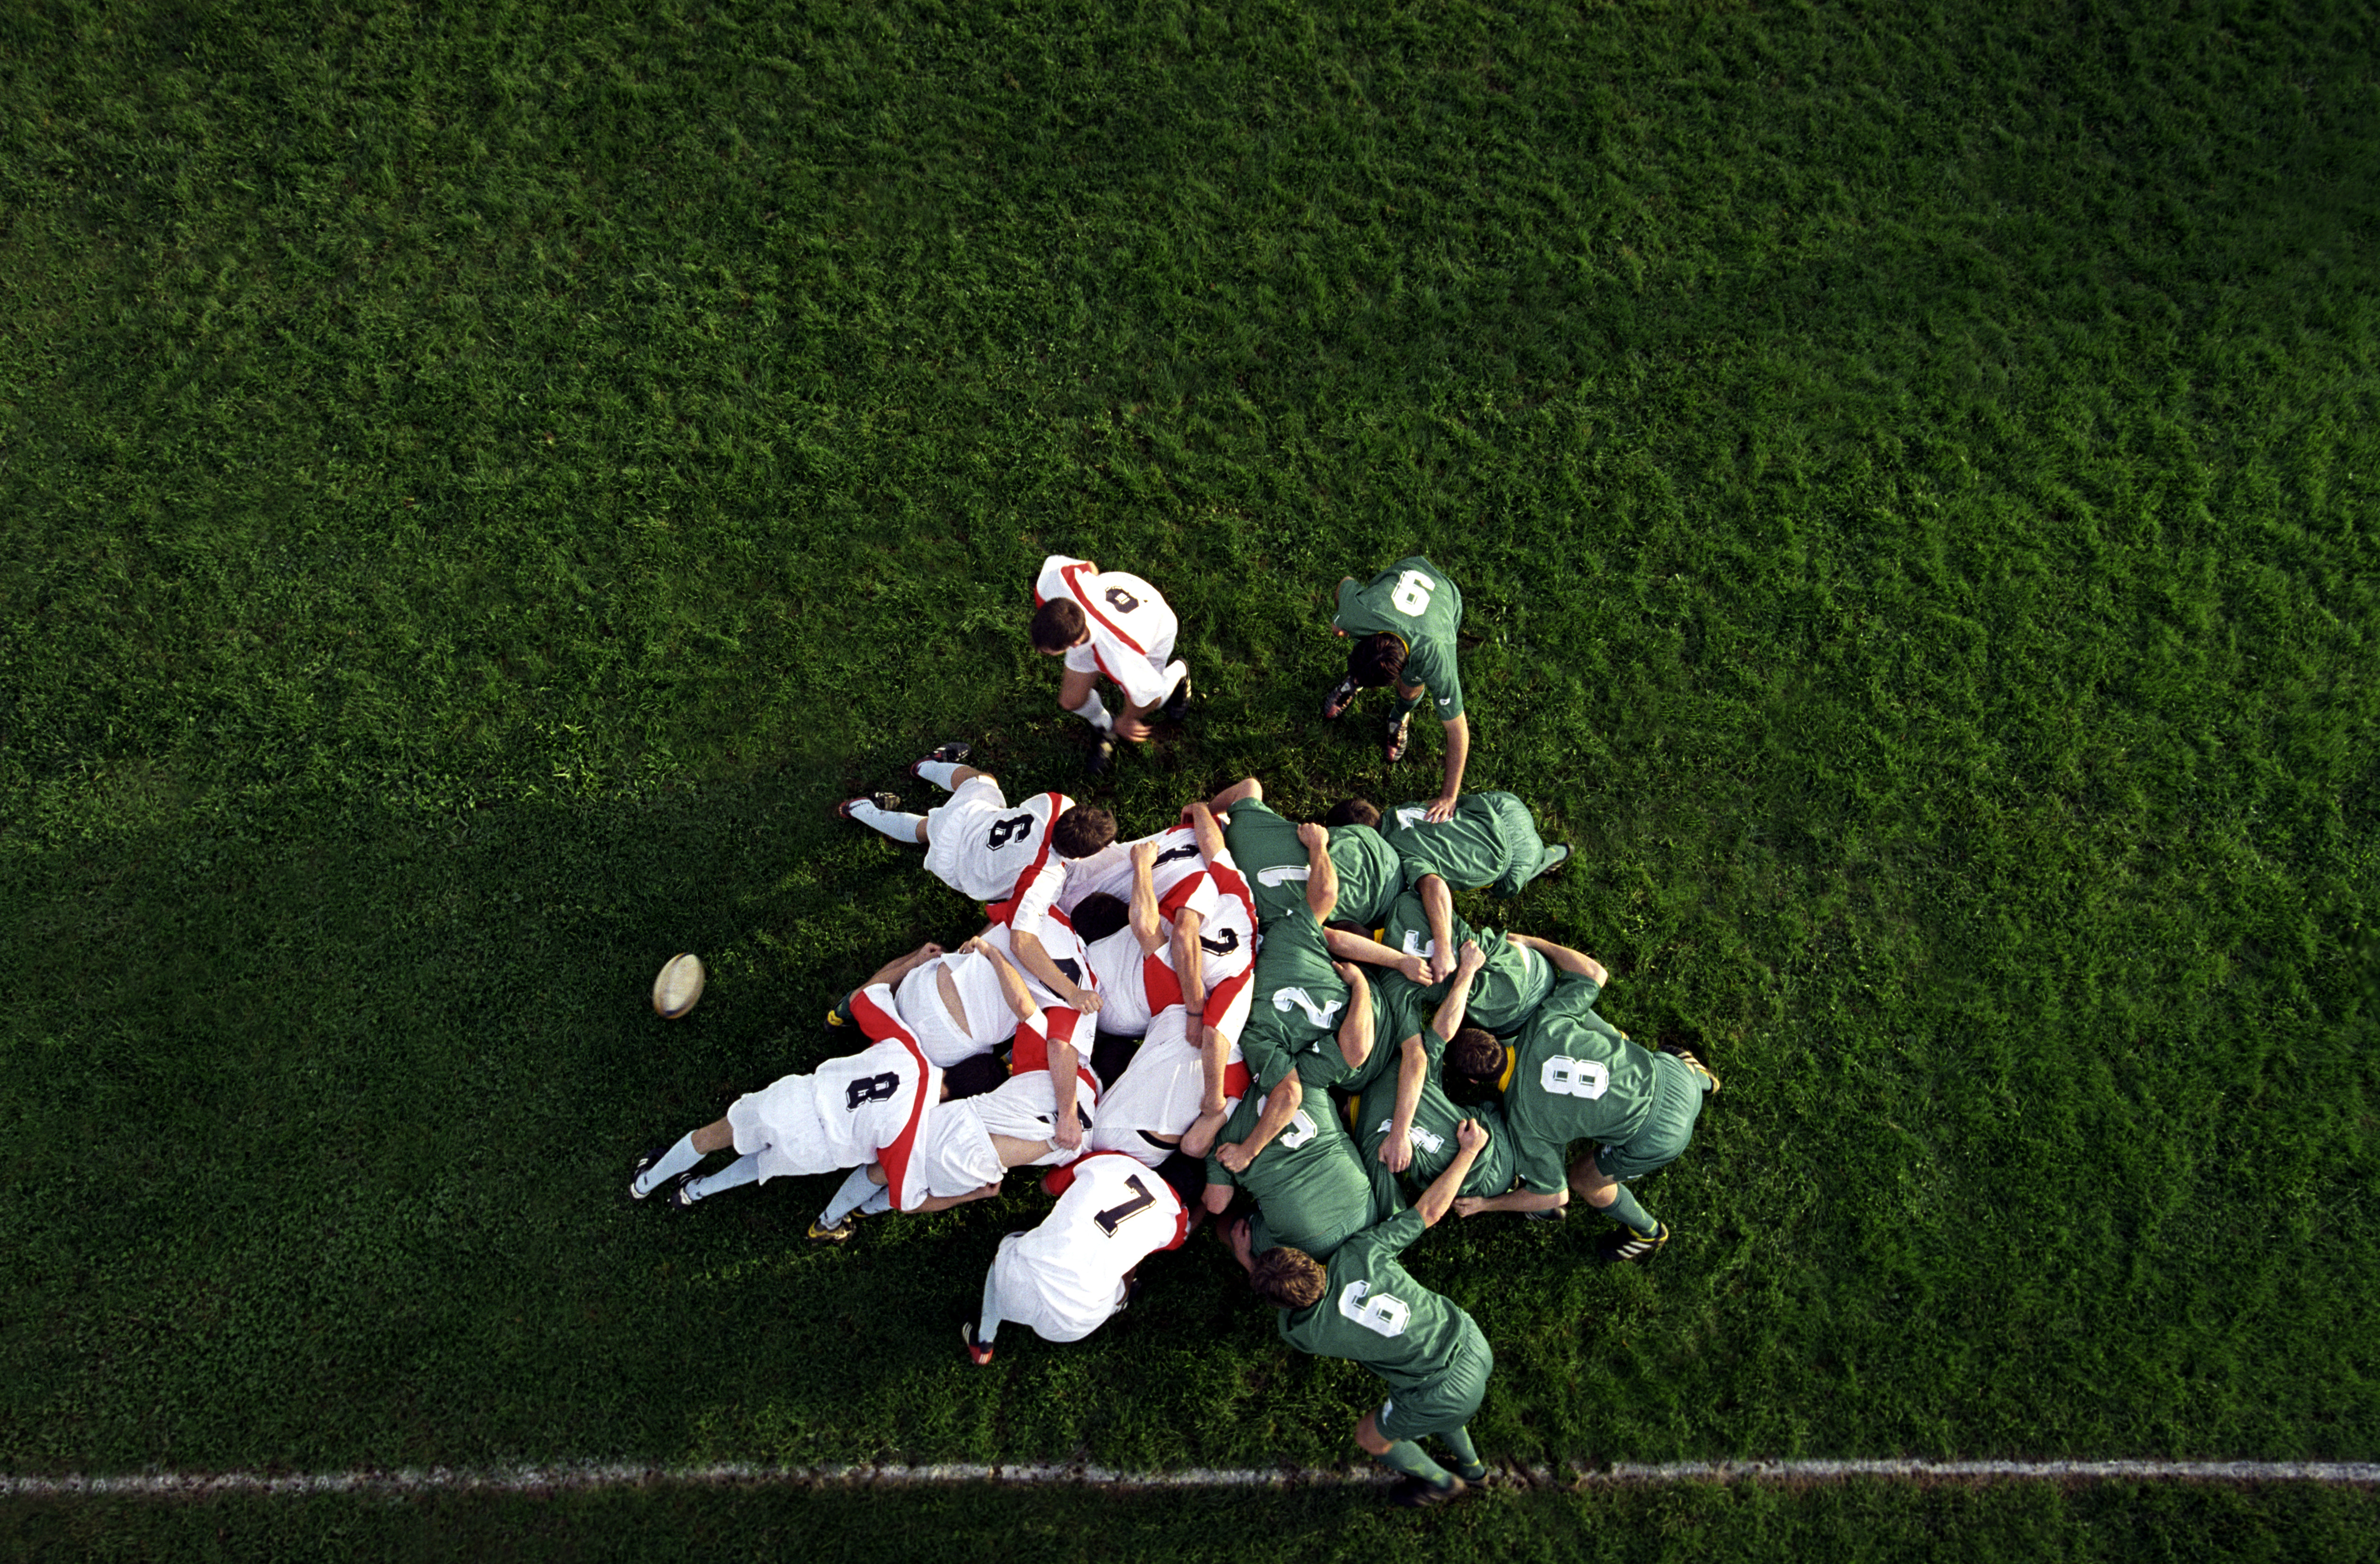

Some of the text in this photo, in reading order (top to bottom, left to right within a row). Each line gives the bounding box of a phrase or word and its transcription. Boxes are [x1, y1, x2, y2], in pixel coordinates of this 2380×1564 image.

[1391, 570, 1435, 617] 9
[1272, 987, 1342, 1029] 2
[845, 1072, 899, 1113] 8
[1540, 1055, 1609, 1099] 8
[1094, 1174, 1156, 1238] 7
[1338, 1280, 1410, 1337] 6
